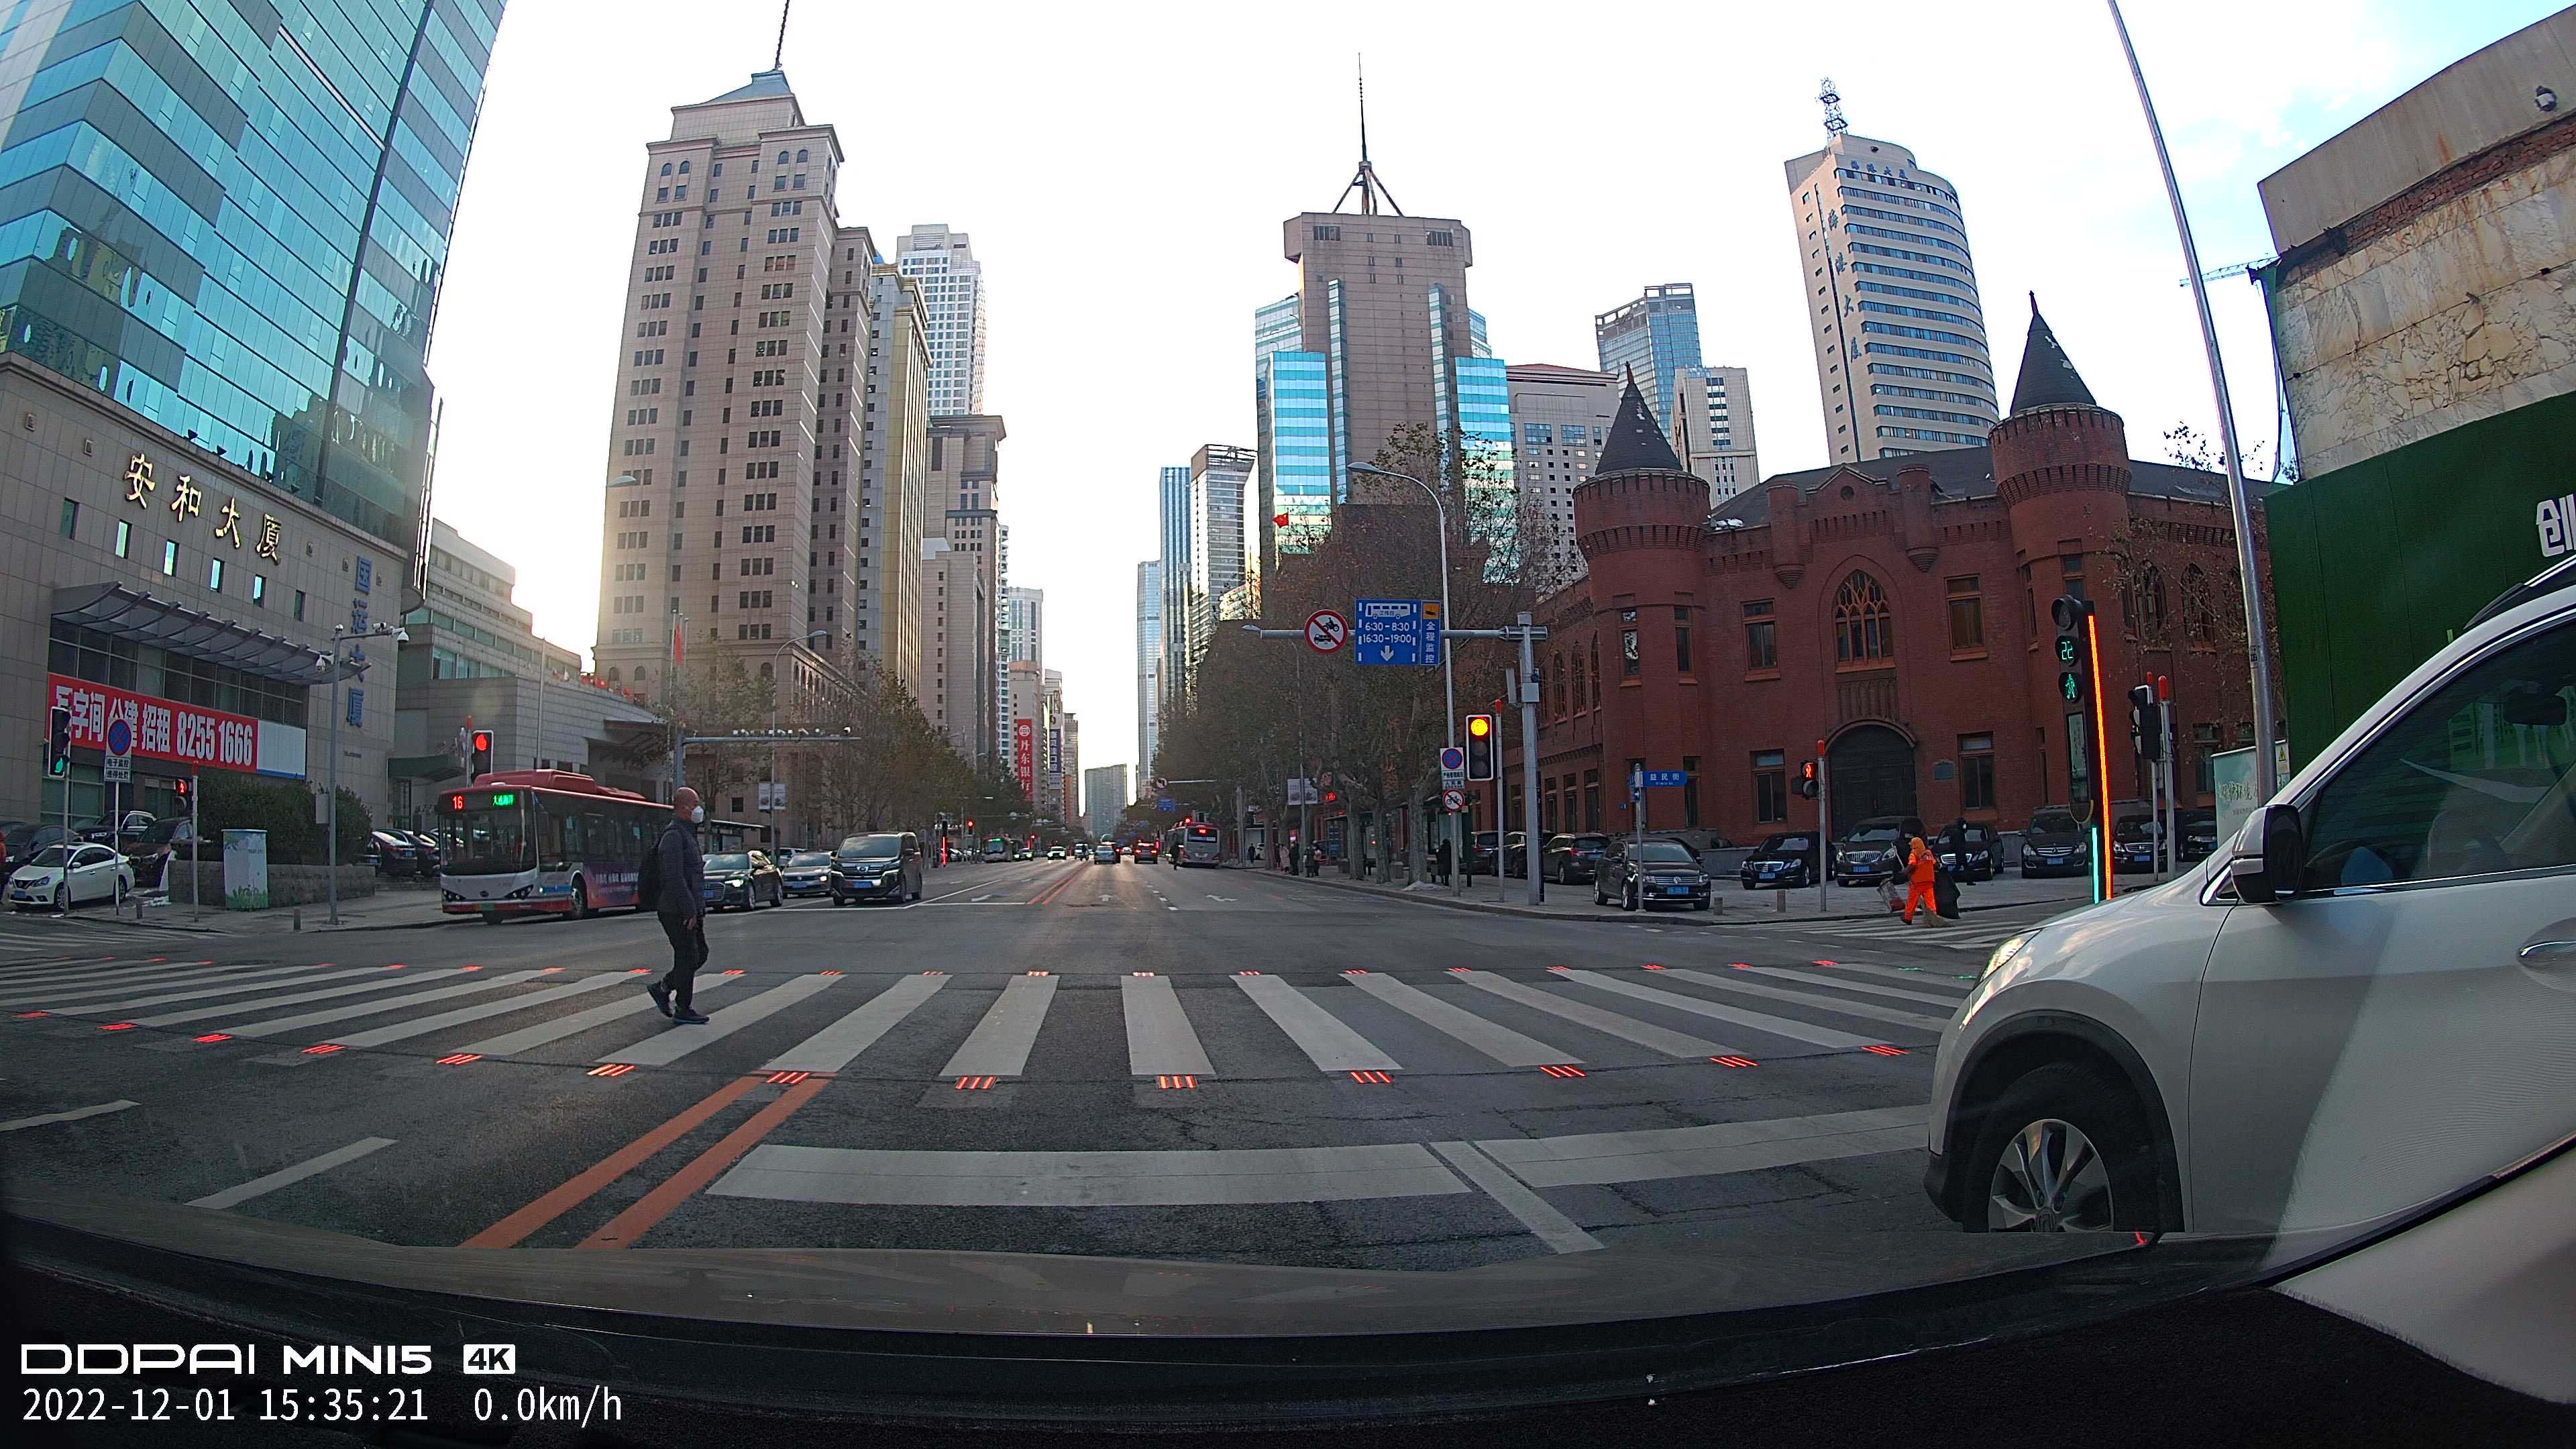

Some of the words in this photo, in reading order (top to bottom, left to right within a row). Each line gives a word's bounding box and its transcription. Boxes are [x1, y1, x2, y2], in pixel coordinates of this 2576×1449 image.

[123, 452, 282, 566] 安和大厦
[1425, 621, 1436, 663] 全程监控
[2061, 641, 2074, 660] 22
[142, 702, 171, 753] 招租
[176, 711, 215, 761] 8255
[219, 720, 253, 766] 1666
[1020, 739, 1031, 791] 丹东银行
[1650, 773, 1680, 781] 益民街
[453, 796, 463, 809] 16
